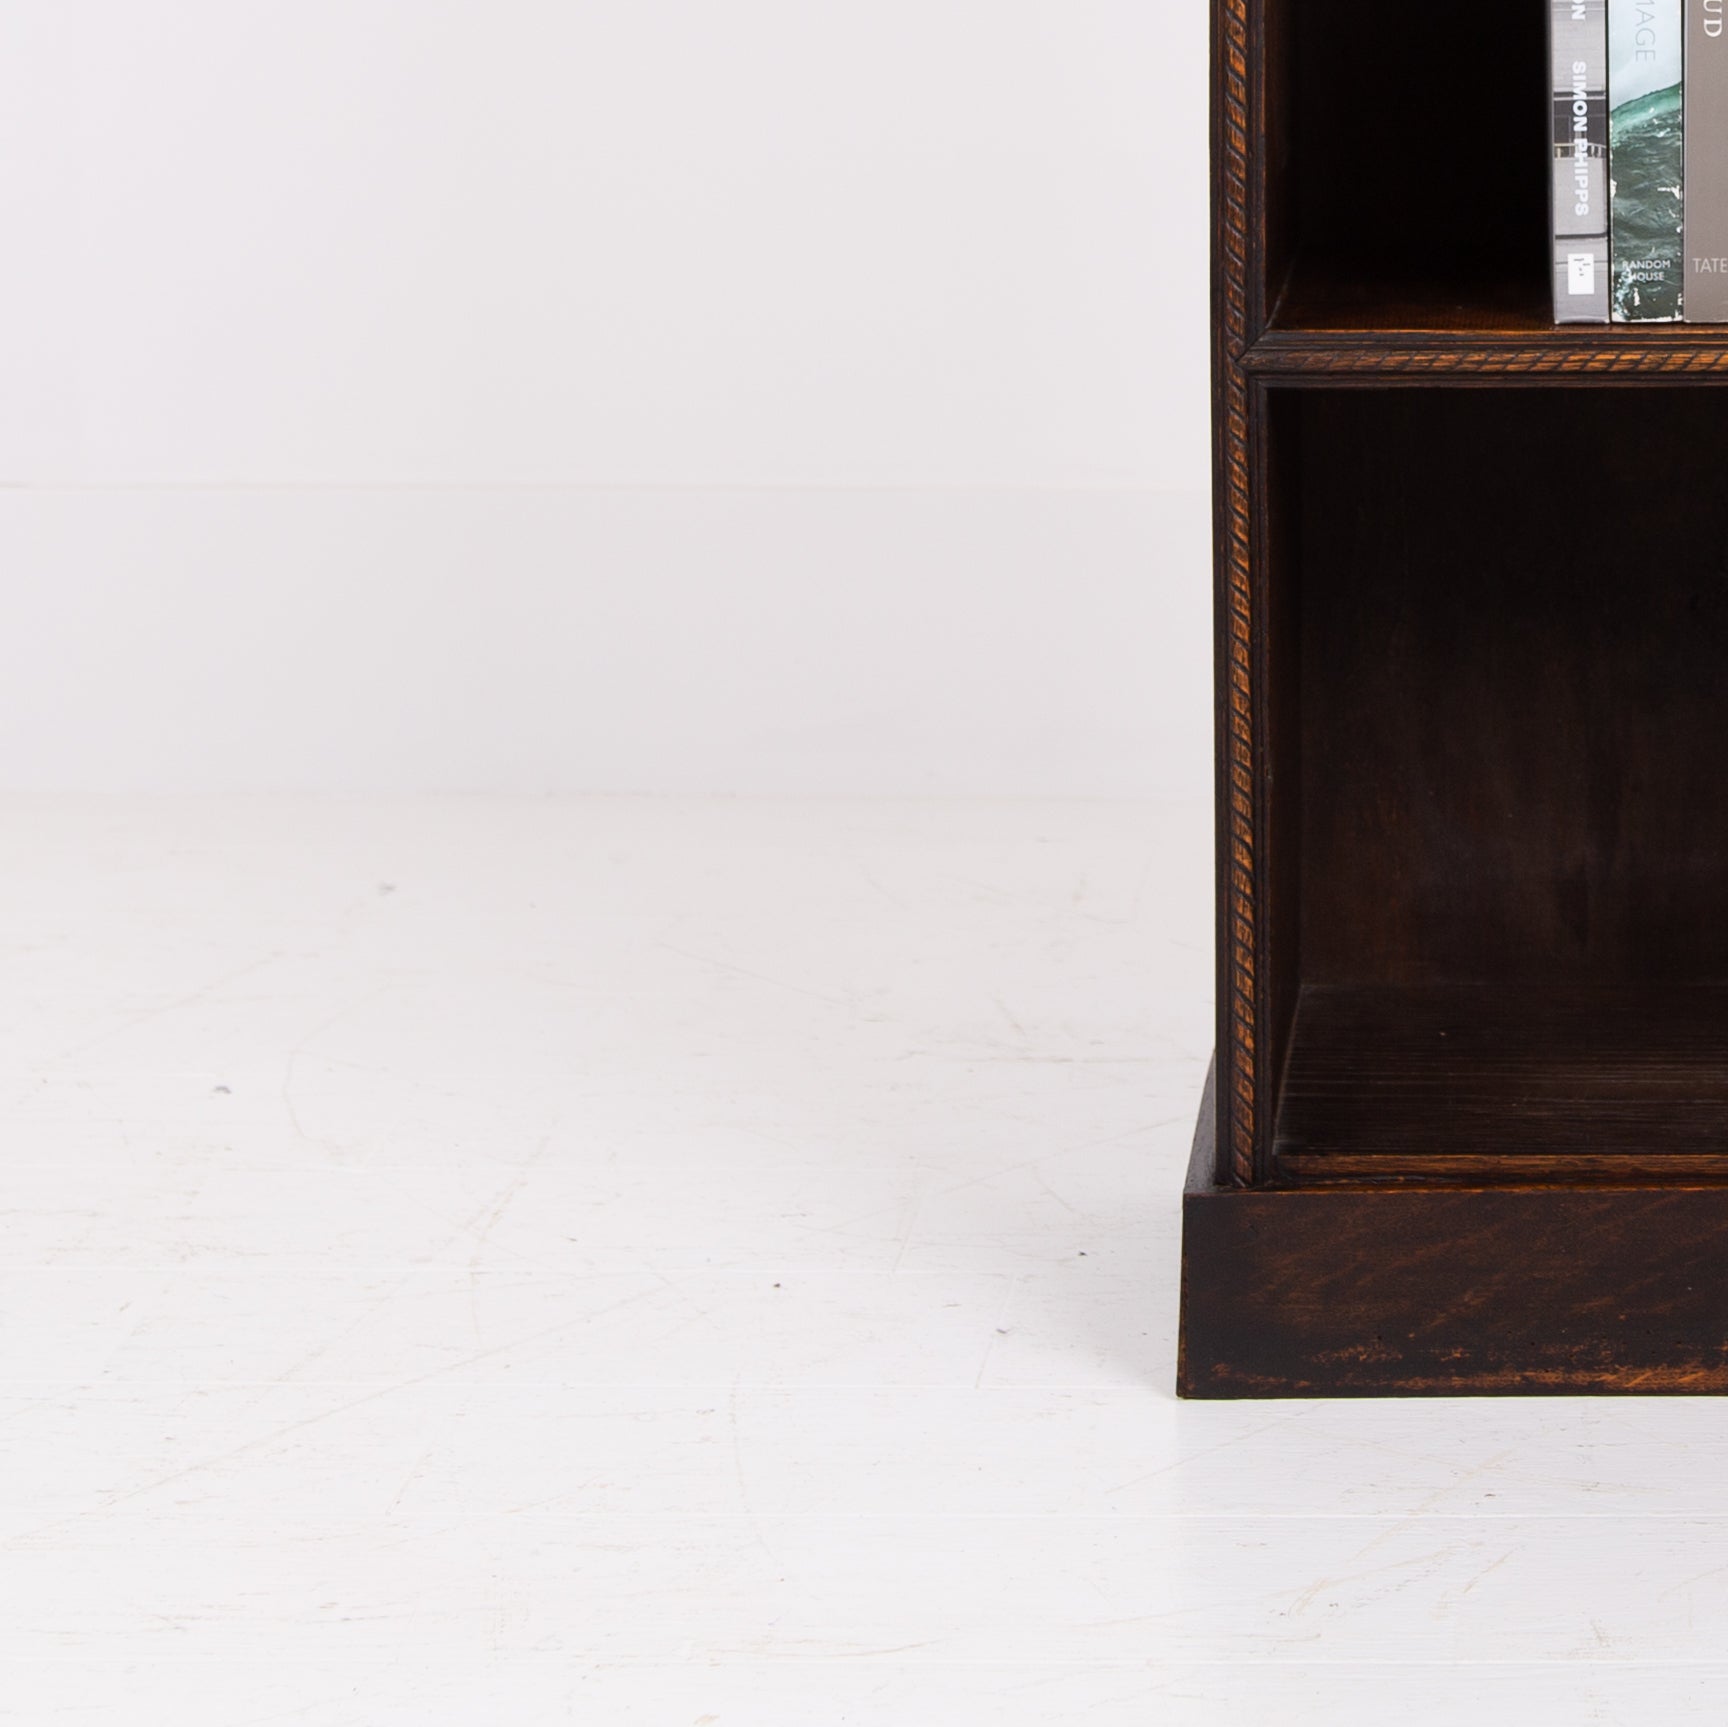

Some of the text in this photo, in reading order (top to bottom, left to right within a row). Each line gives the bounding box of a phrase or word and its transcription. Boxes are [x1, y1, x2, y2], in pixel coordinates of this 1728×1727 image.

[1572, 61, 1587, 132] SIMON
[1573, 138, 1589, 217] PHIPPS
[1622, 260, 1671, 269] RANDOM
[1692, 258, 1728, 273] TATE
[1626, 272, 1665, 281] HOUSE
